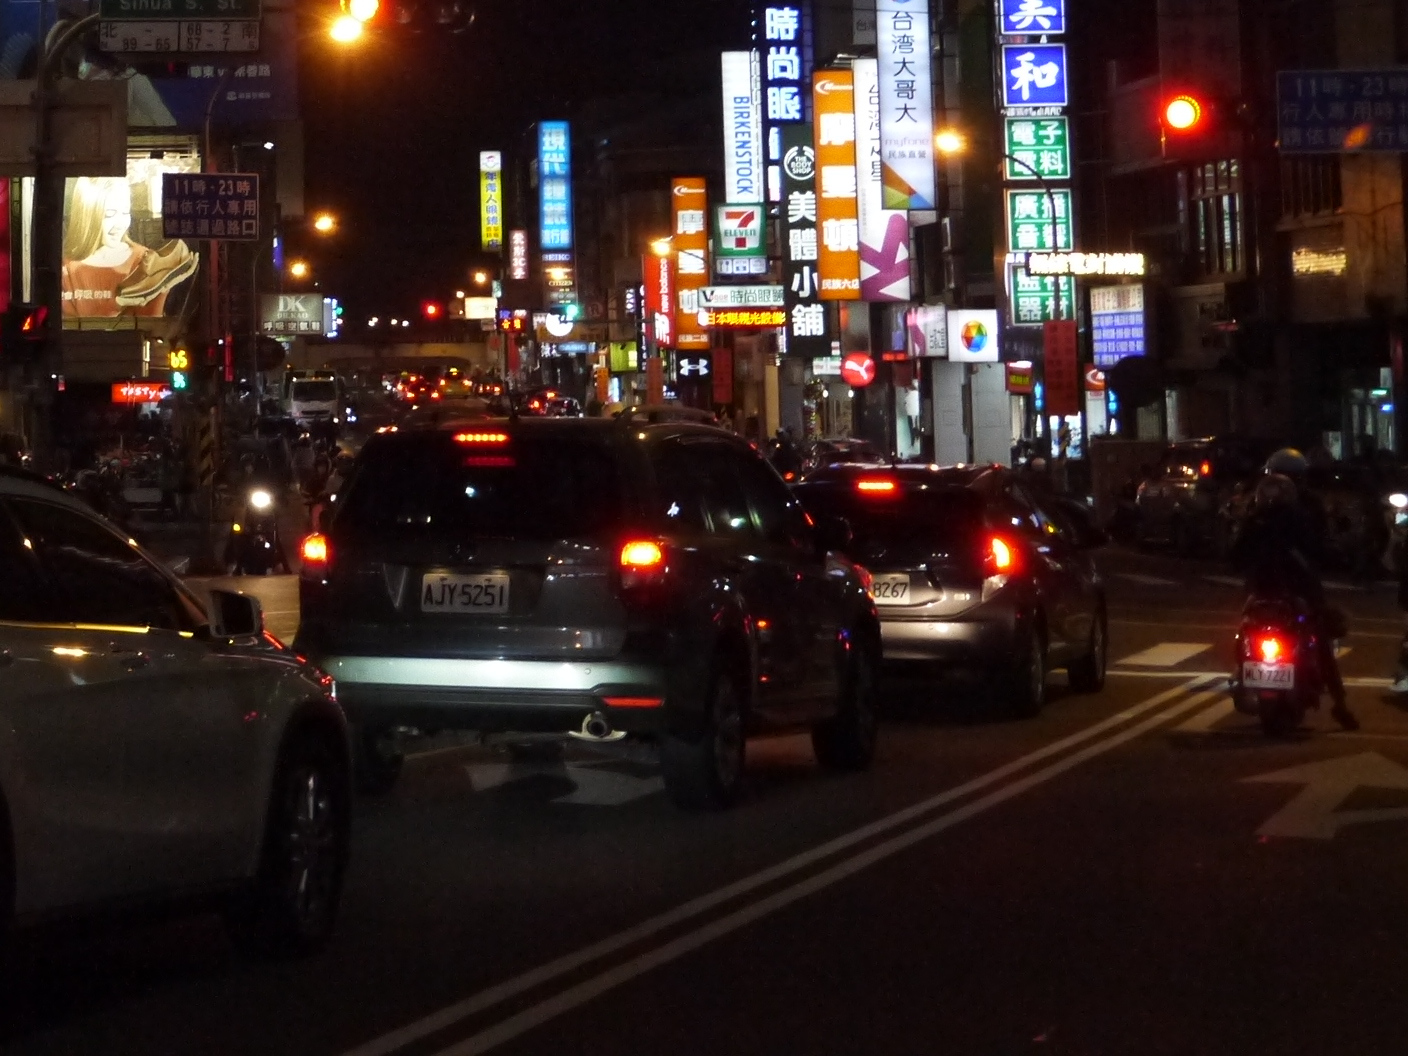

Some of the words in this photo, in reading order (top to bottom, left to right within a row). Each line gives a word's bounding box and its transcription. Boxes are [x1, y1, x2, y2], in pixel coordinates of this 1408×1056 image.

[733, 96, 753, 194] BIRKENSTOCK
[1012, 120, 1062, 145] 電子
[1013, 150, 1064, 175] 電料
[542, 253, 571, 262] SEIKO
[659, 258, 669, 295] balance
[278, 295, 307, 312] DK
[661, 296, 670, 313] new
